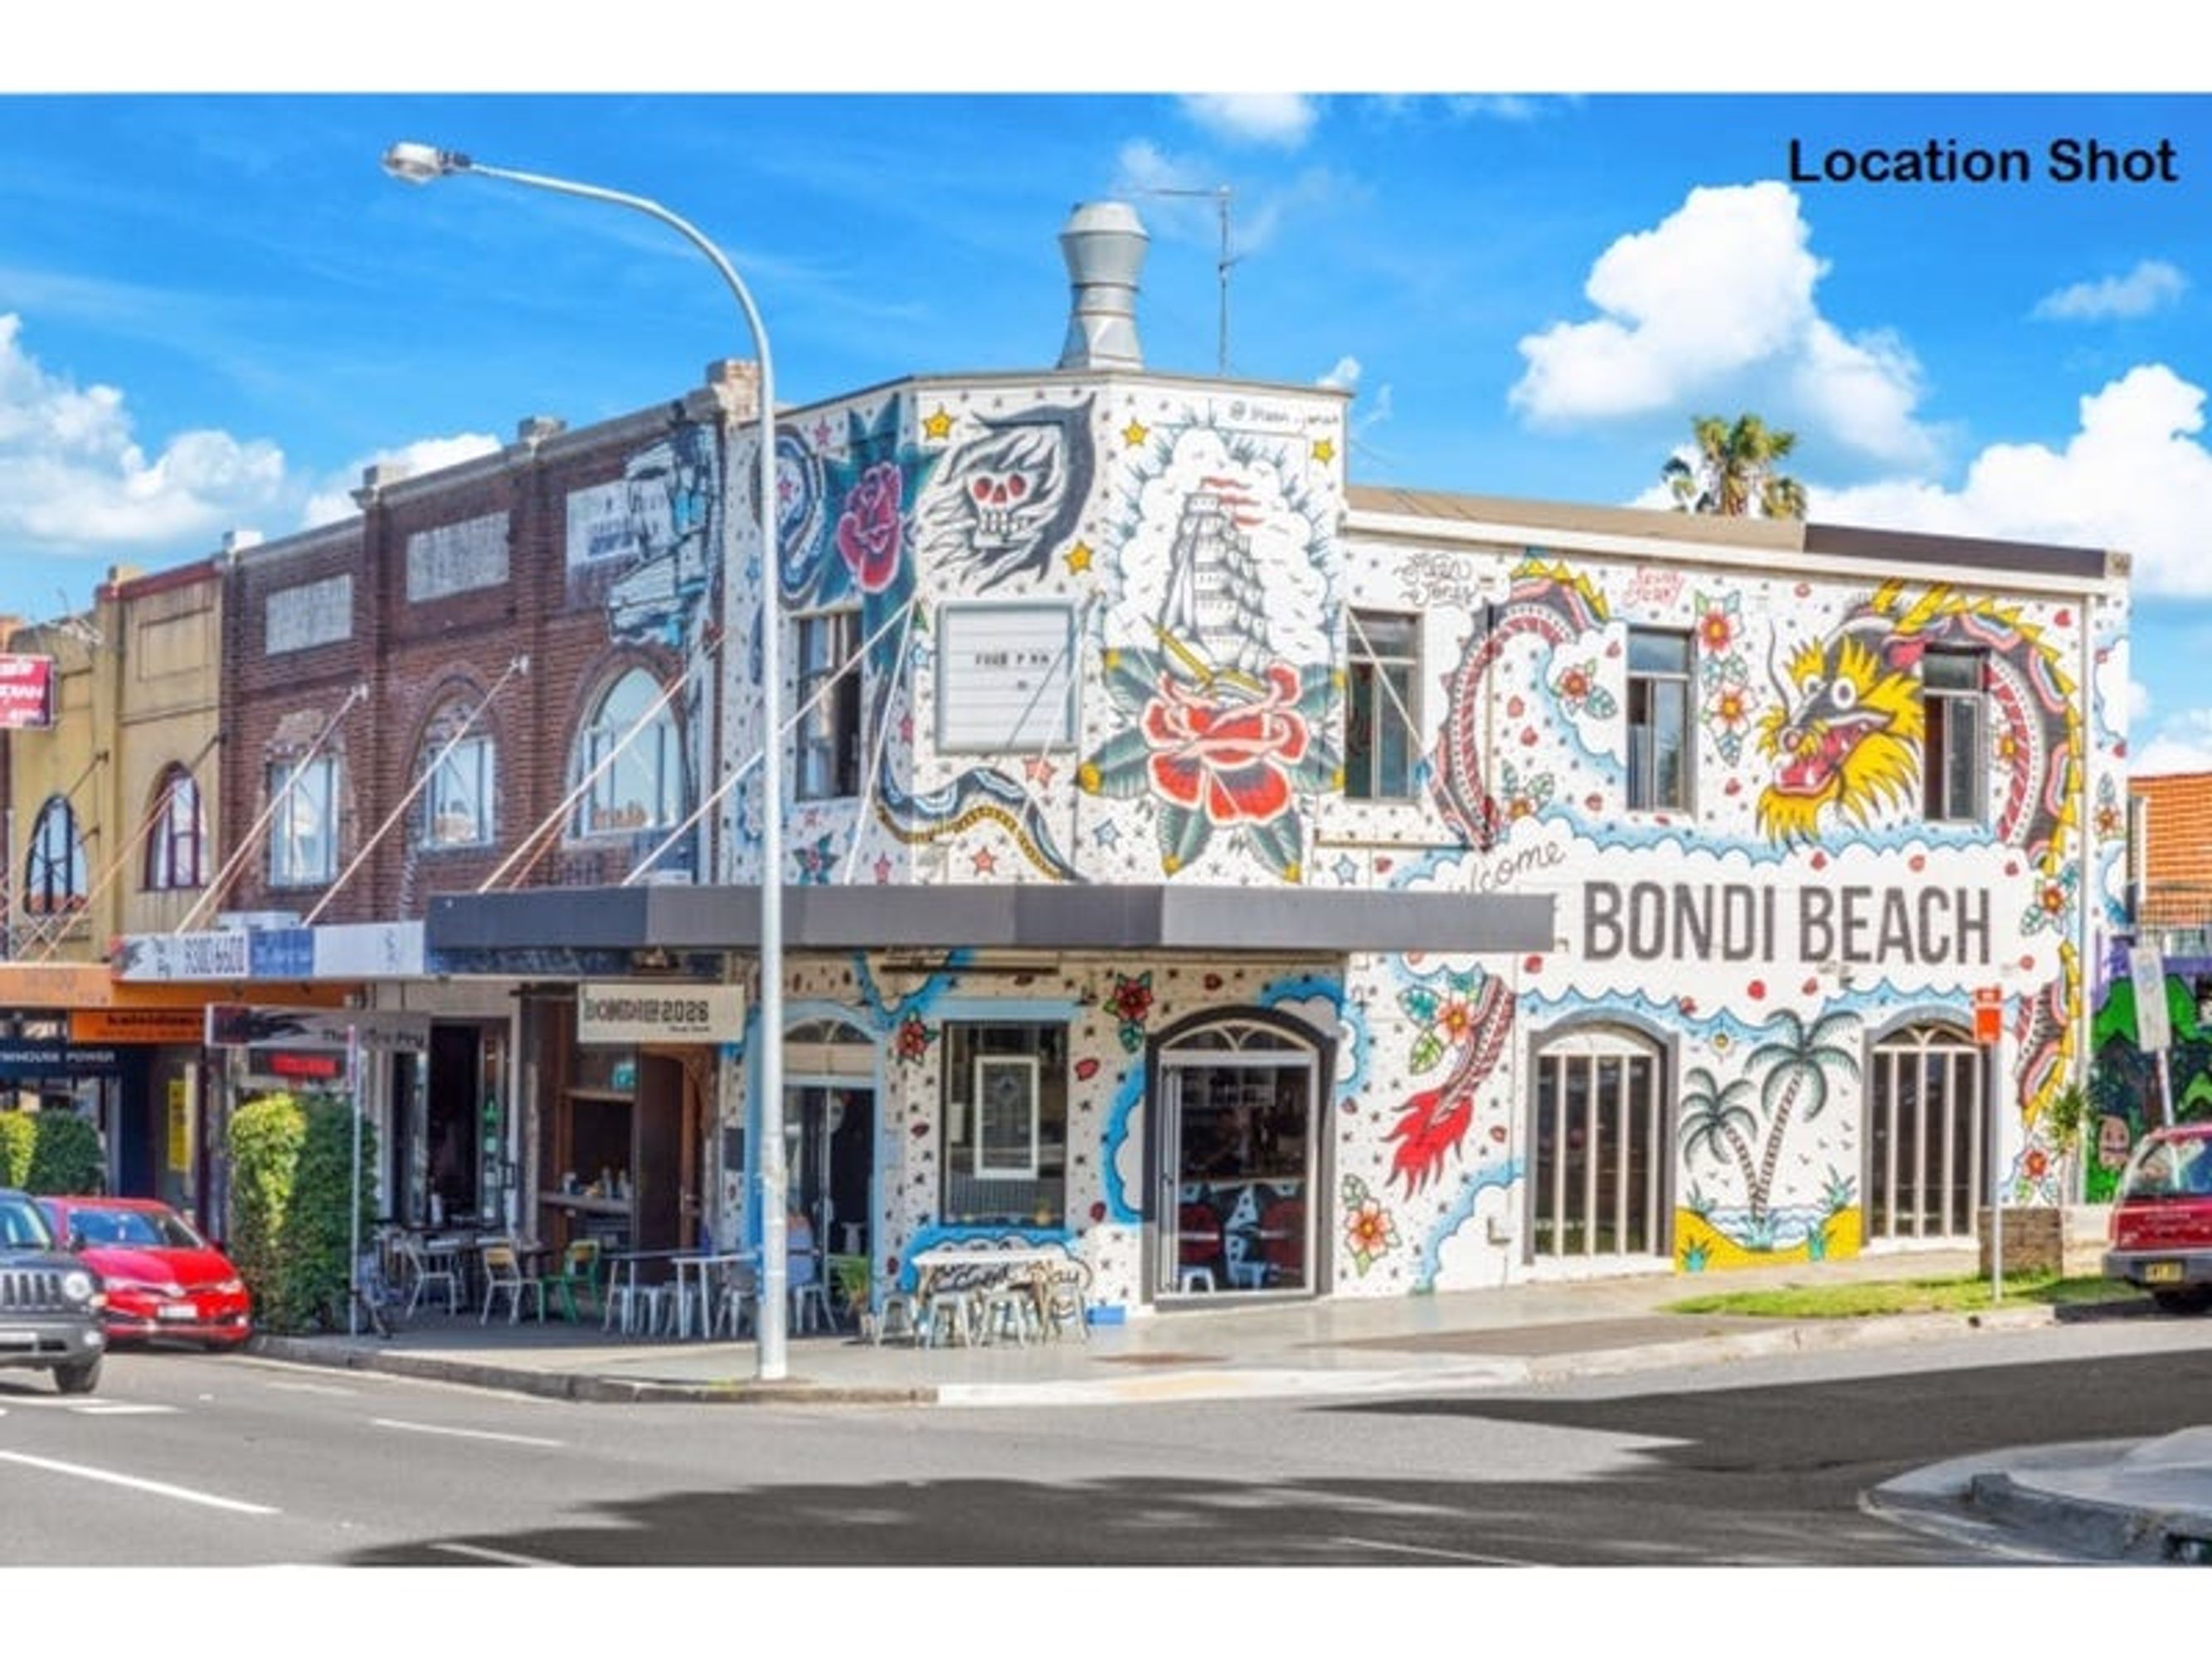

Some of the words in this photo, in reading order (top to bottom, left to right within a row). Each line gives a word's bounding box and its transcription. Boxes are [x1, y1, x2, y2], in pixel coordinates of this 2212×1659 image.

[1584, 881, 1775, 961] BONDI
[1798, 886, 1991, 966] BEACH
[66, 1051, 114, 1063] POWER
